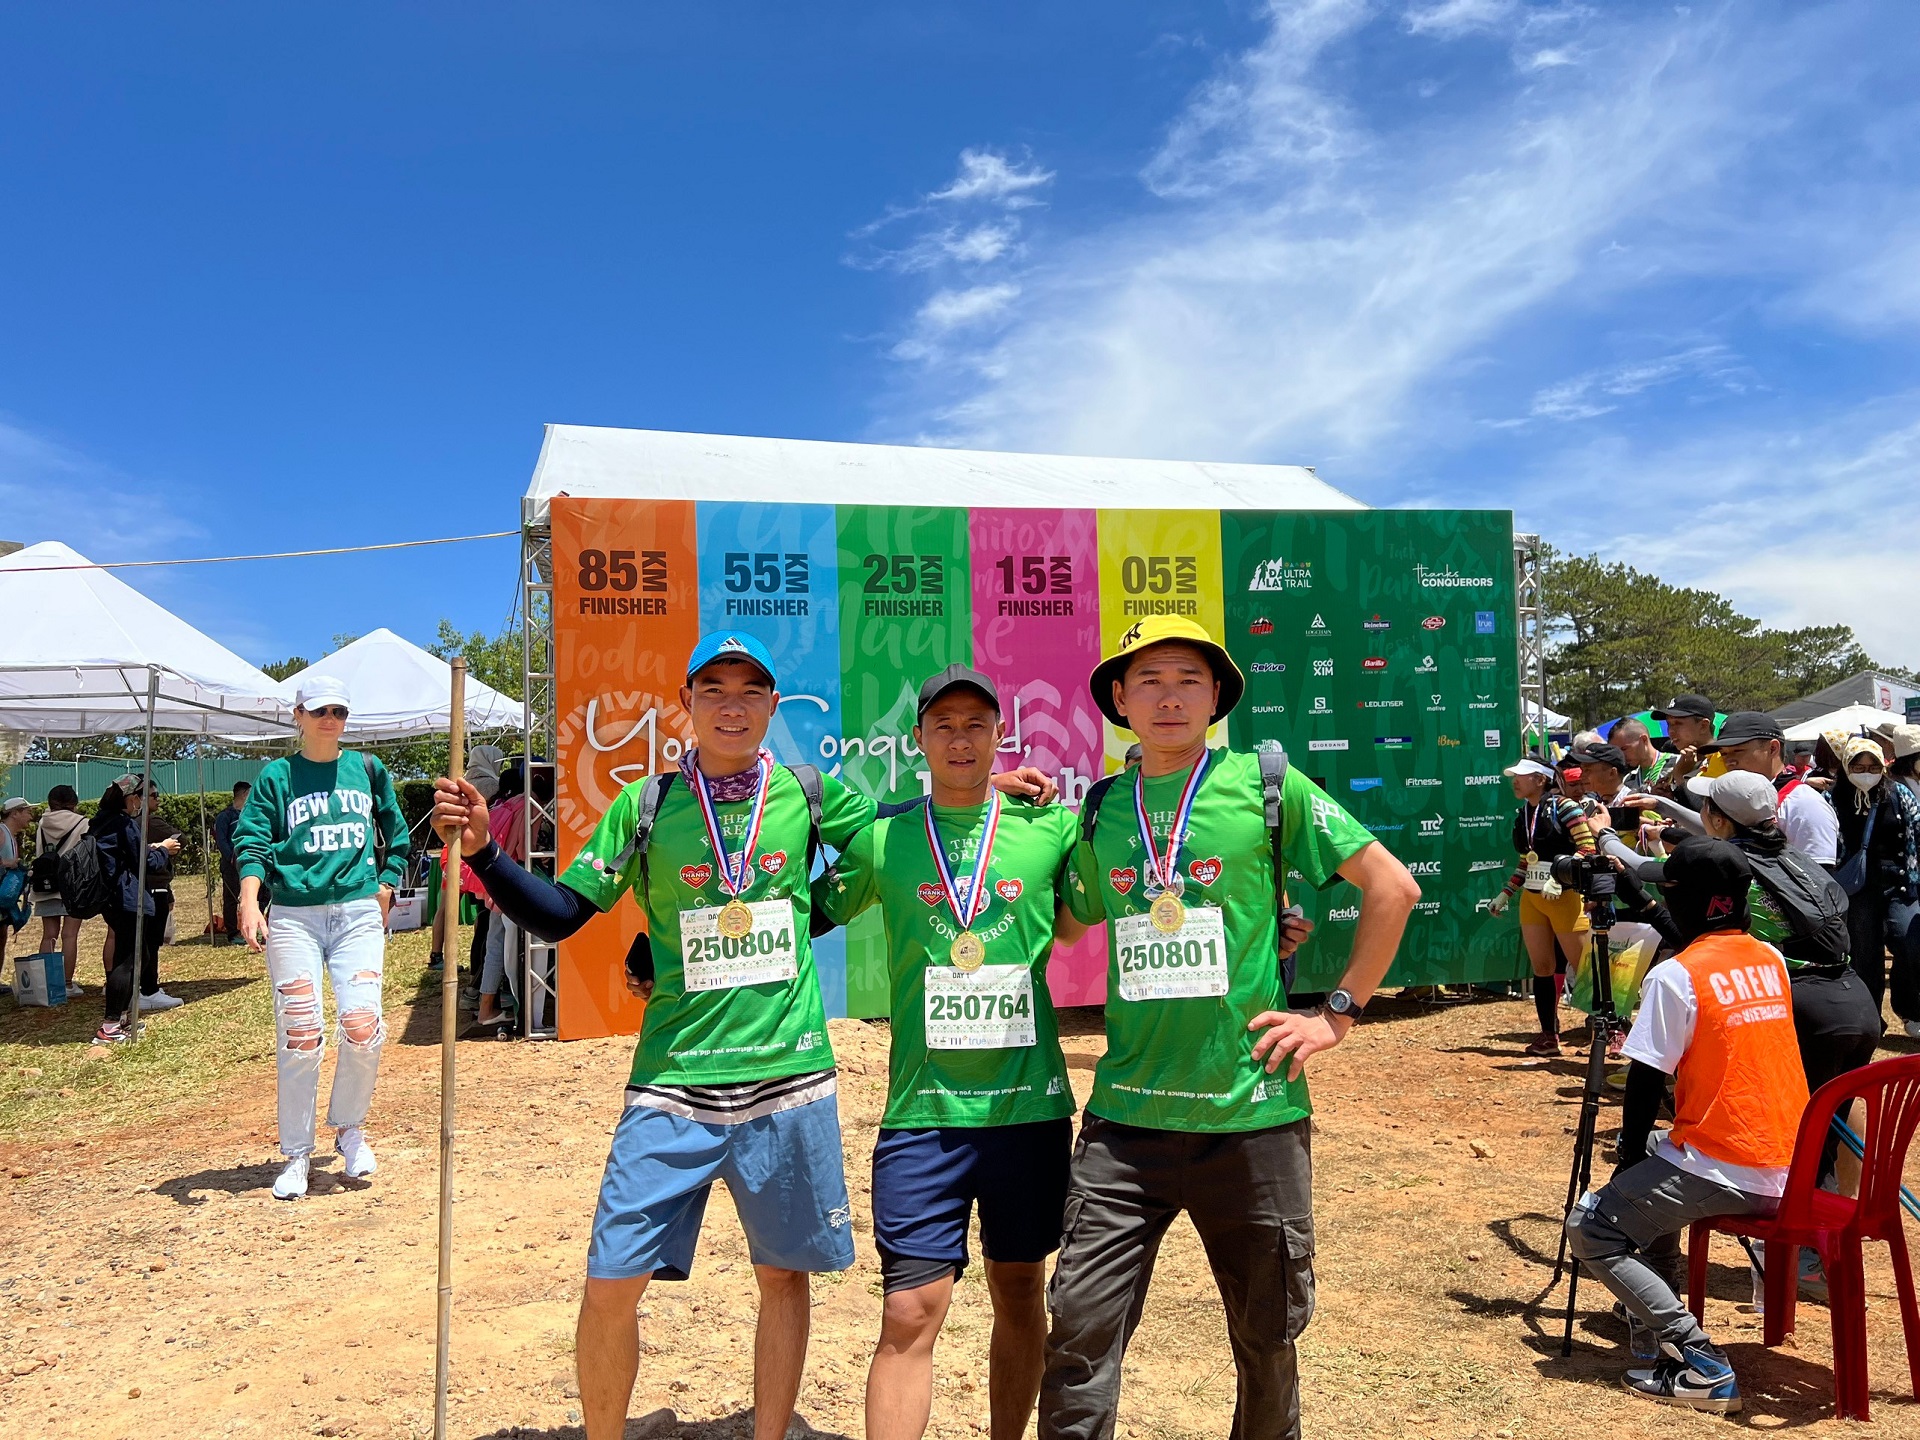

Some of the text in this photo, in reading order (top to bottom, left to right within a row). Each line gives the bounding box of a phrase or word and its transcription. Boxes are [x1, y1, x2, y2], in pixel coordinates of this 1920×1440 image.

[578, 549, 638, 592] 85
[642, 551, 667, 592] KM
[724, 553, 810, 594] 55 KM
[863, 554, 916, 594] 25
[920, 556, 944, 594] KM
[996, 556, 1046, 594] 15
[1050, 556, 1072, 594] KM
[1122, 556, 1197, 594] 05 KM
[1284, 570, 1312, 578] ULTRA
[1412, 562, 1460, 584] thanks
[1285, 580, 1312, 588] TRAIL
[1422, 578, 1494, 587] CONQUERORS
[580, 598, 667, 615] FINISHER
[726, 599, 808, 616] FINISHER
[864, 600, 944, 616] FINISHER
[998, 600, 1074, 616] FINISHER
[1124, 600, 1197, 616] FINISHER
[1314, 667, 1334, 676] XIM
[1465, 776, 1500, 786] CRAMPFIX
[287, 790, 372, 834] NEW YOR
[718, 814, 744, 824] HE
[1147, 811, 1176, 823] HE
[1421, 820, 1440, 830] TTC
[304, 822, 365, 852] JETS
[682, 870, 710, 878] THANKS
[1419, 862, 1441, 873] ACC
[1526, 871, 1550, 880] 51163
[928, 913, 1016, 943] CONEROR
[687, 928, 792, 963] 250804
[1120, 939, 1217, 974] 250801
[1709, 964, 1782, 1005] CREW
[930, 994, 1030, 1020] 250764
[1167, 1090, 1196, 1098] distance
